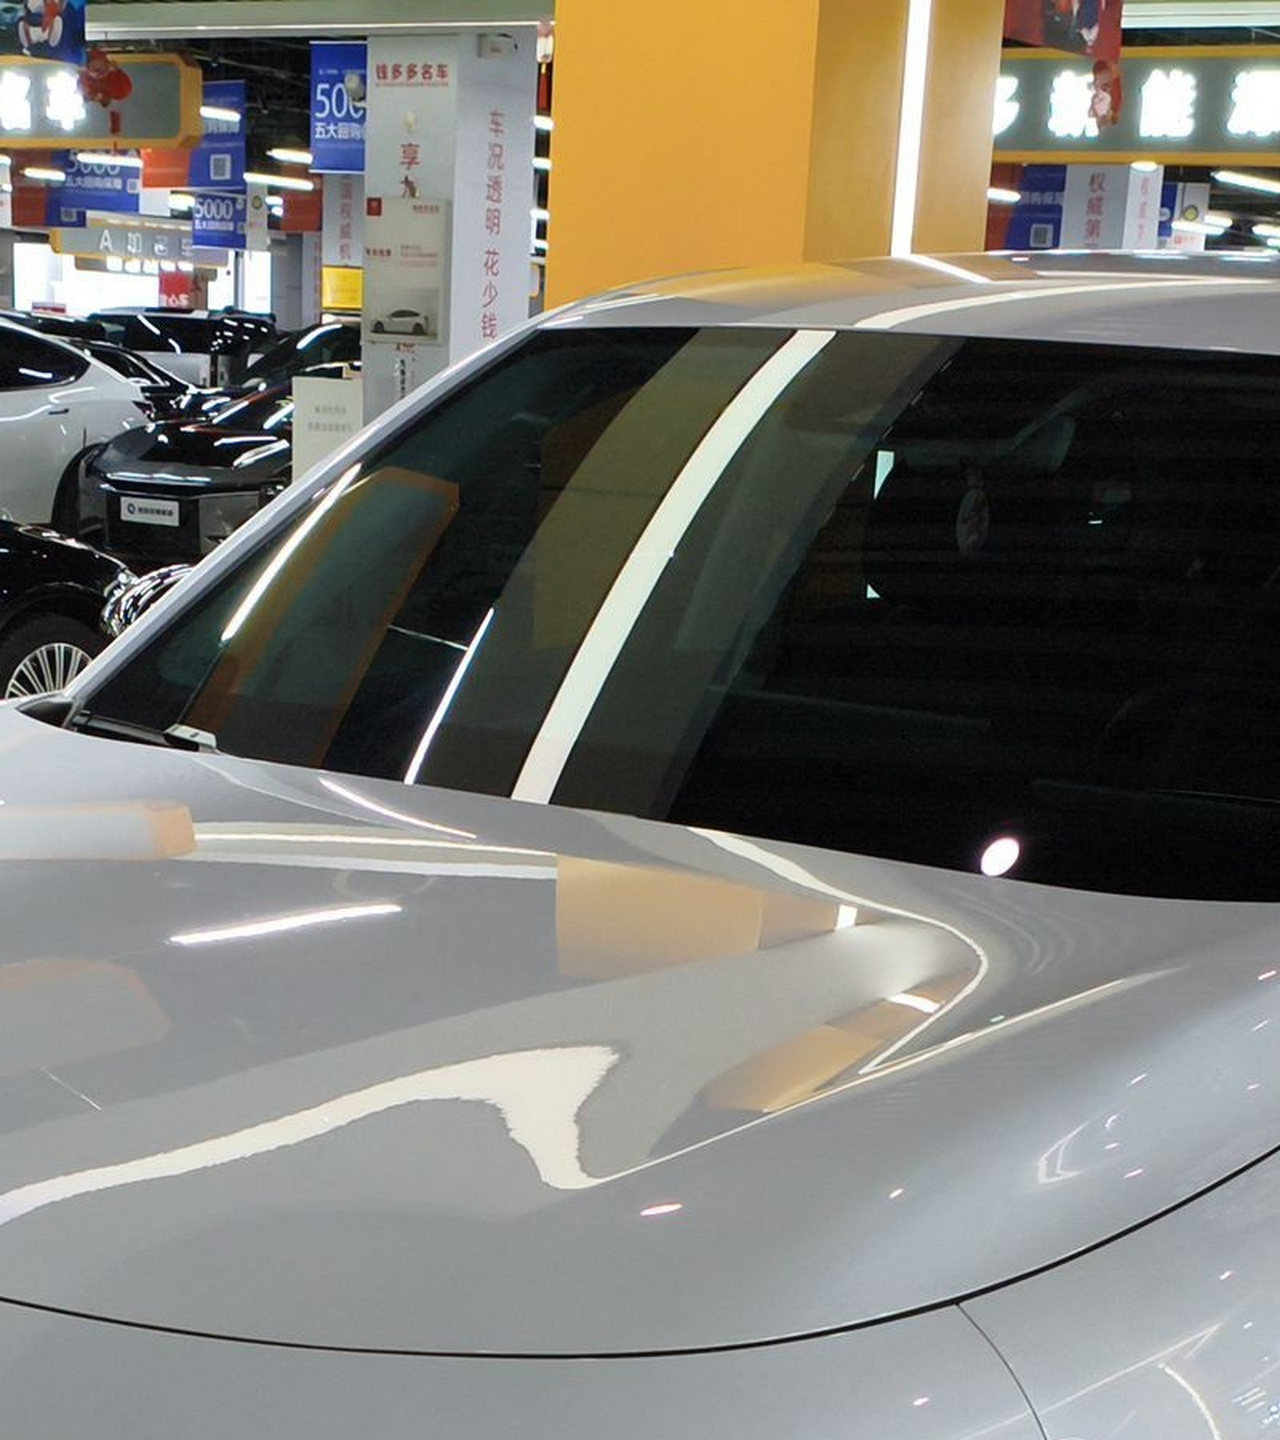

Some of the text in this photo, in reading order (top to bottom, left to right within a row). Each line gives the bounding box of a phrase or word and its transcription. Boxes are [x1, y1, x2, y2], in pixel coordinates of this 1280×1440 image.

[376, 63, 449, 80] 钱多多名车
